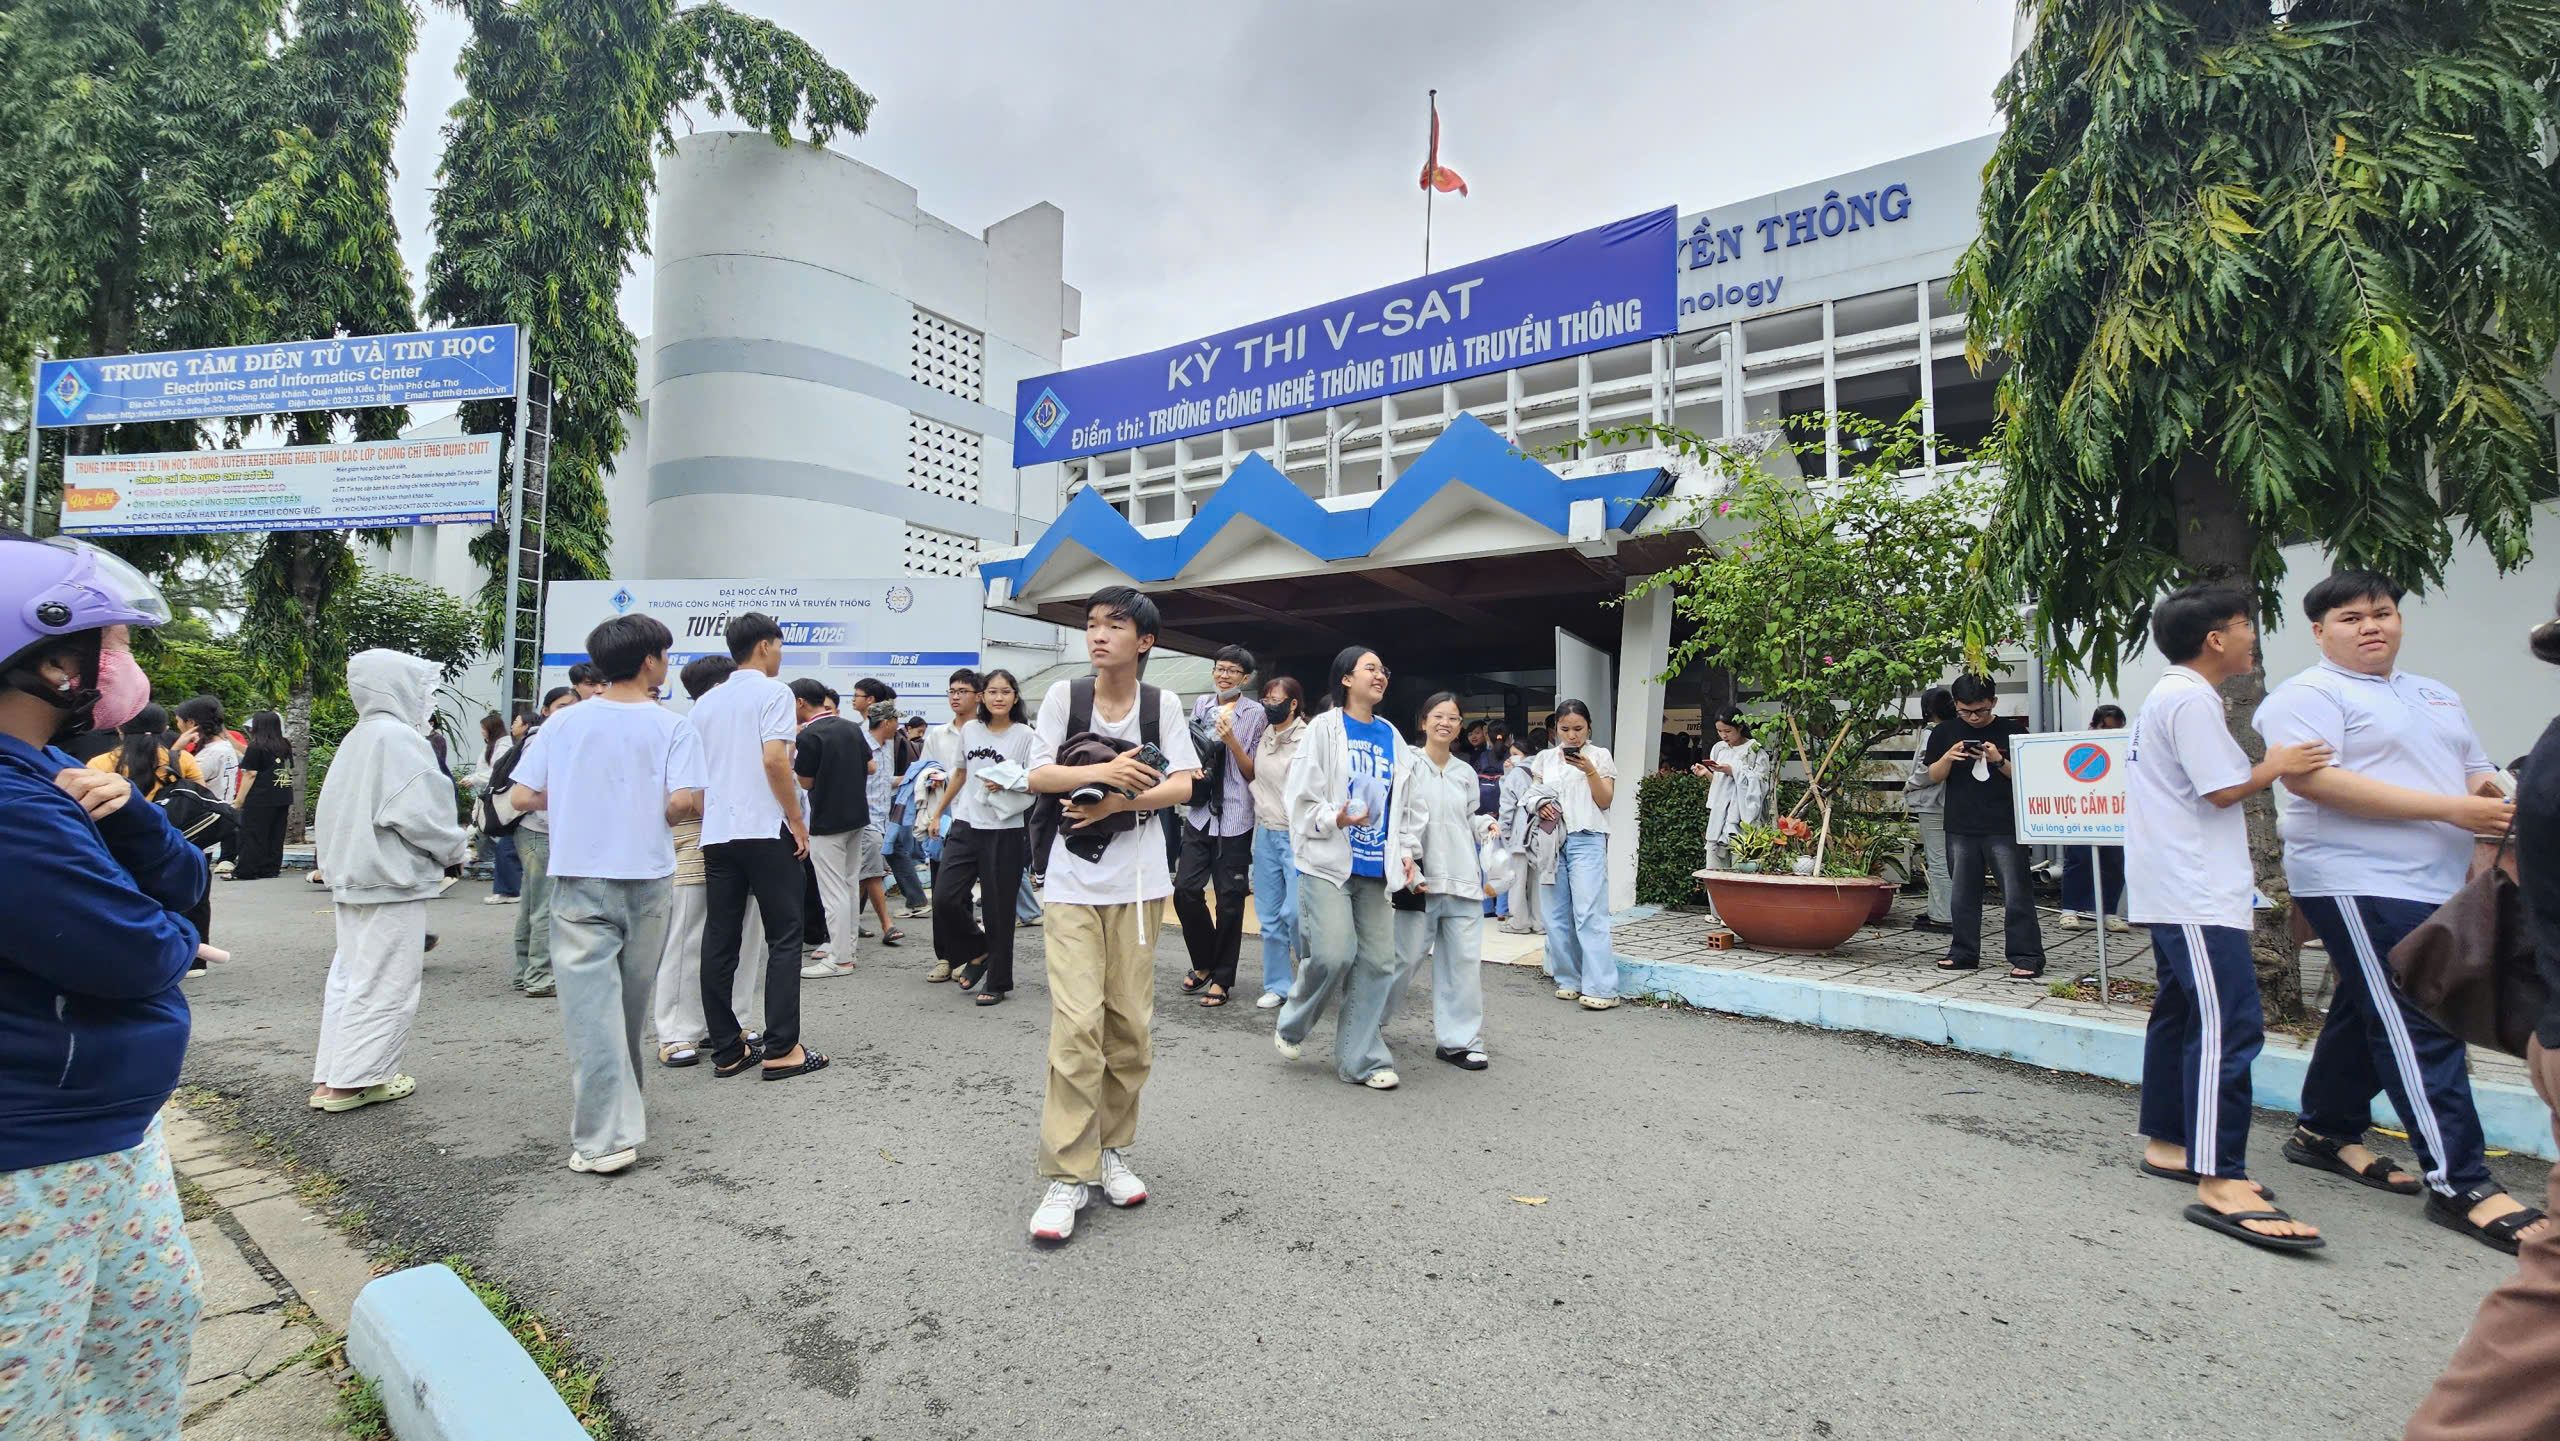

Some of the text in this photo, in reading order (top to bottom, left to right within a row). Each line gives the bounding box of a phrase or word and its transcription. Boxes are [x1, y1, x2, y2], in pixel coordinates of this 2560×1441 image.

[1756, 182, 1912, 253] THÔNG
[1167, 277, 1485, 392] KỲ THI V-SAT
[100, 335, 495, 382] TRUNG TÂM ĐIỆN TỬ VÀ TIN HỌC
[164, 366, 422, 395] Electronics and Informatics Center
[1071, 418, 1111, 451] Điểm
[1116, 416, 1144, 442] thi:
[1148, 398, 1211, 437] TRƯỜNG
[1215, 387, 1263, 422] CÔNG
[1266, 369, 1316, 409] NGHỆ
[1321, 359, 1385, 400] THÔNG
[1390, 349, 1424, 385] TIN
[1429, 336, 1458, 376] VÀ
[1463, 313, 1552, 368] TRUYỀN
[1558, 298, 1642, 347] THÔNG
[260, 392, 280, 400] Xuân
[312, 387, 333, 398] Quận
[335, 386, 354, 395] Ninh
[378, 382, 404, 392] Thành
[406, 379, 422, 390] Phố
[424, 379, 440, 389] Cần
[443, 378, 460, 387] Thơ
[360, 395, 374, 403] 735
[404, 390, 431, 400] Email:
[648, 599, 683, 608] TRƯỜNG
[685, 598, 710, 608] CÔNG
[712, 598, 736, 609] NGHỆ
[738, 598, 768, 608] THÔNG
[789, 597, 801, 607] VÀ
[803, 596, 837, 607] TRUYỀN
[839, 598, 871, 607] THÔNG
[719, 586, 798, 598] ĐẠI HỌC CẦN THƠ
[810, 626, 846, 643] 2026
[890, 652, 920, 666] Thạc sĩ
[2028, 796, 2051, 815] KHU
[2054, 794, 2077, 819] VỰC
[2080, 788, 2108, 815] CẤM
[2031, 823, 2044, 832] Vui
[2046, 823, 2065, 834] lòng
[2095, 823, 2112, 832] vào
